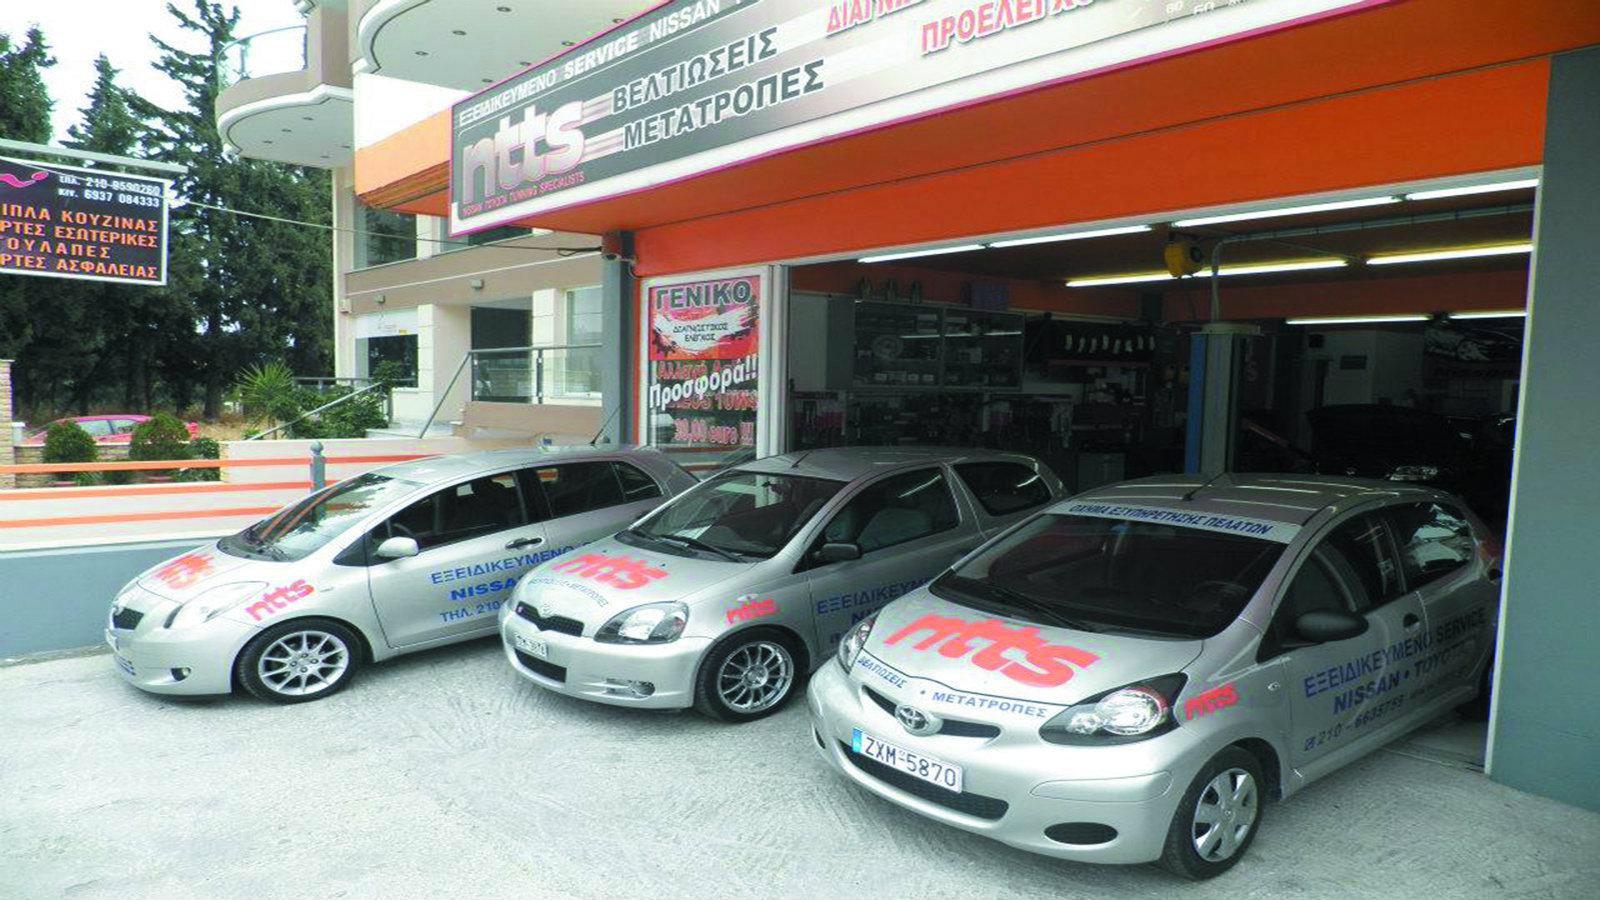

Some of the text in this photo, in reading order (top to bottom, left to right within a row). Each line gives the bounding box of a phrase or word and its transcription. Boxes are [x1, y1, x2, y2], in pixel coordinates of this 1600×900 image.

[563, 32, 640, 80] SERVICE
[649, 0, 721, 40] NISSAN
[612, 27, 778, 115] ΒΕΛΤΙΩΣΕΙΣ
[623, 60, 824, 151] ΜΕΤΑΤΡΟΠΕΣ
[61, 210, 158, 232] ΚΟΥΖΙΝΑΣ
[54, 226, 158, 248] ΕΣΩΤΕΡΙΚΕΣ
[56, 258, 158, 279] ΑΣΦΑΛΕΙΑΣ
[655, 280, 753, 311] ΓΕΝΙΚΟ
[449, 575, 523, 601] NISSA
[931, 690, 1050, 719] ΜΕΤΑΤΡΟΠΕΣ
[1333, 672, 1400, 715] NISSAN
